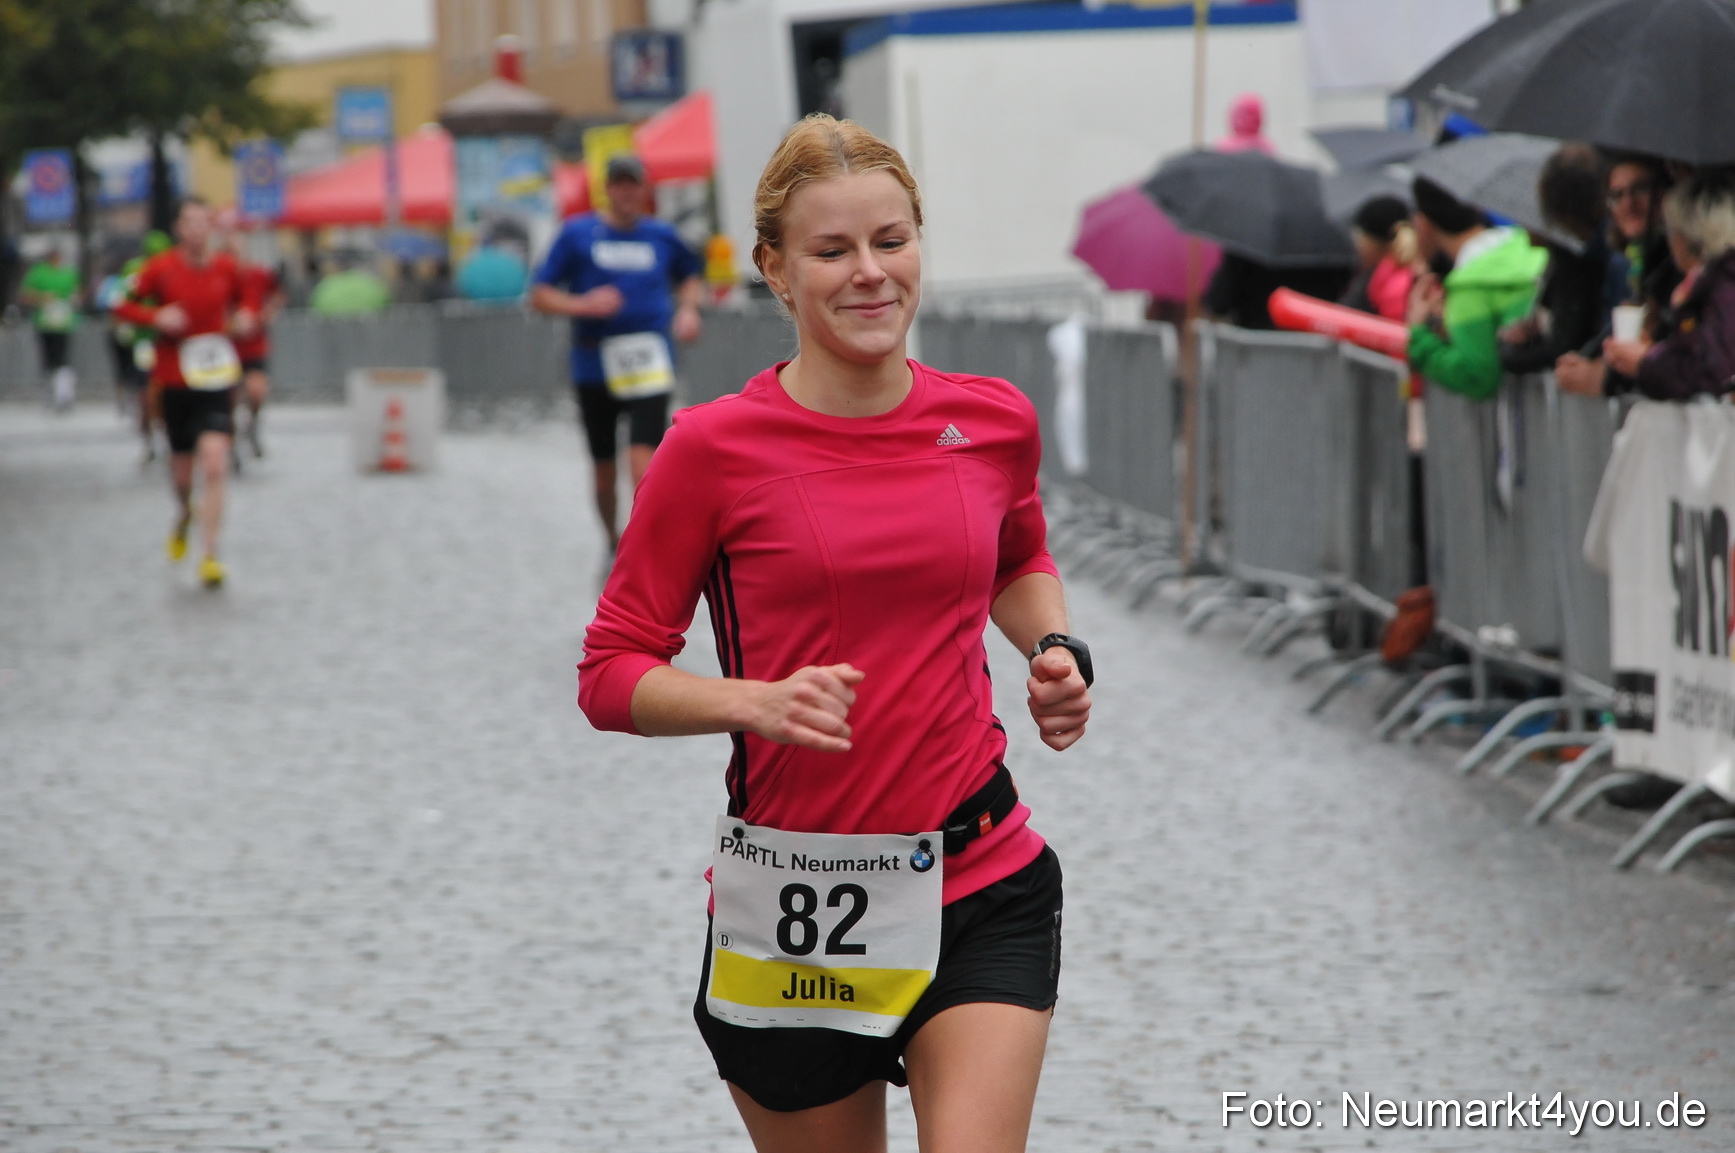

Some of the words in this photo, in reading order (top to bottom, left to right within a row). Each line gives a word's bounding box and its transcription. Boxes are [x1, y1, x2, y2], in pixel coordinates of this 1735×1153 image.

[936, 437, 971, 446] adidas
[720, 835, 785, 869] PARTL
[791, 853, 900, 872] Neumarkt
[776, 883, 869, 956] 82
[721, 934, 729, 947] D
[781, 972, 855, 1003] Julia
